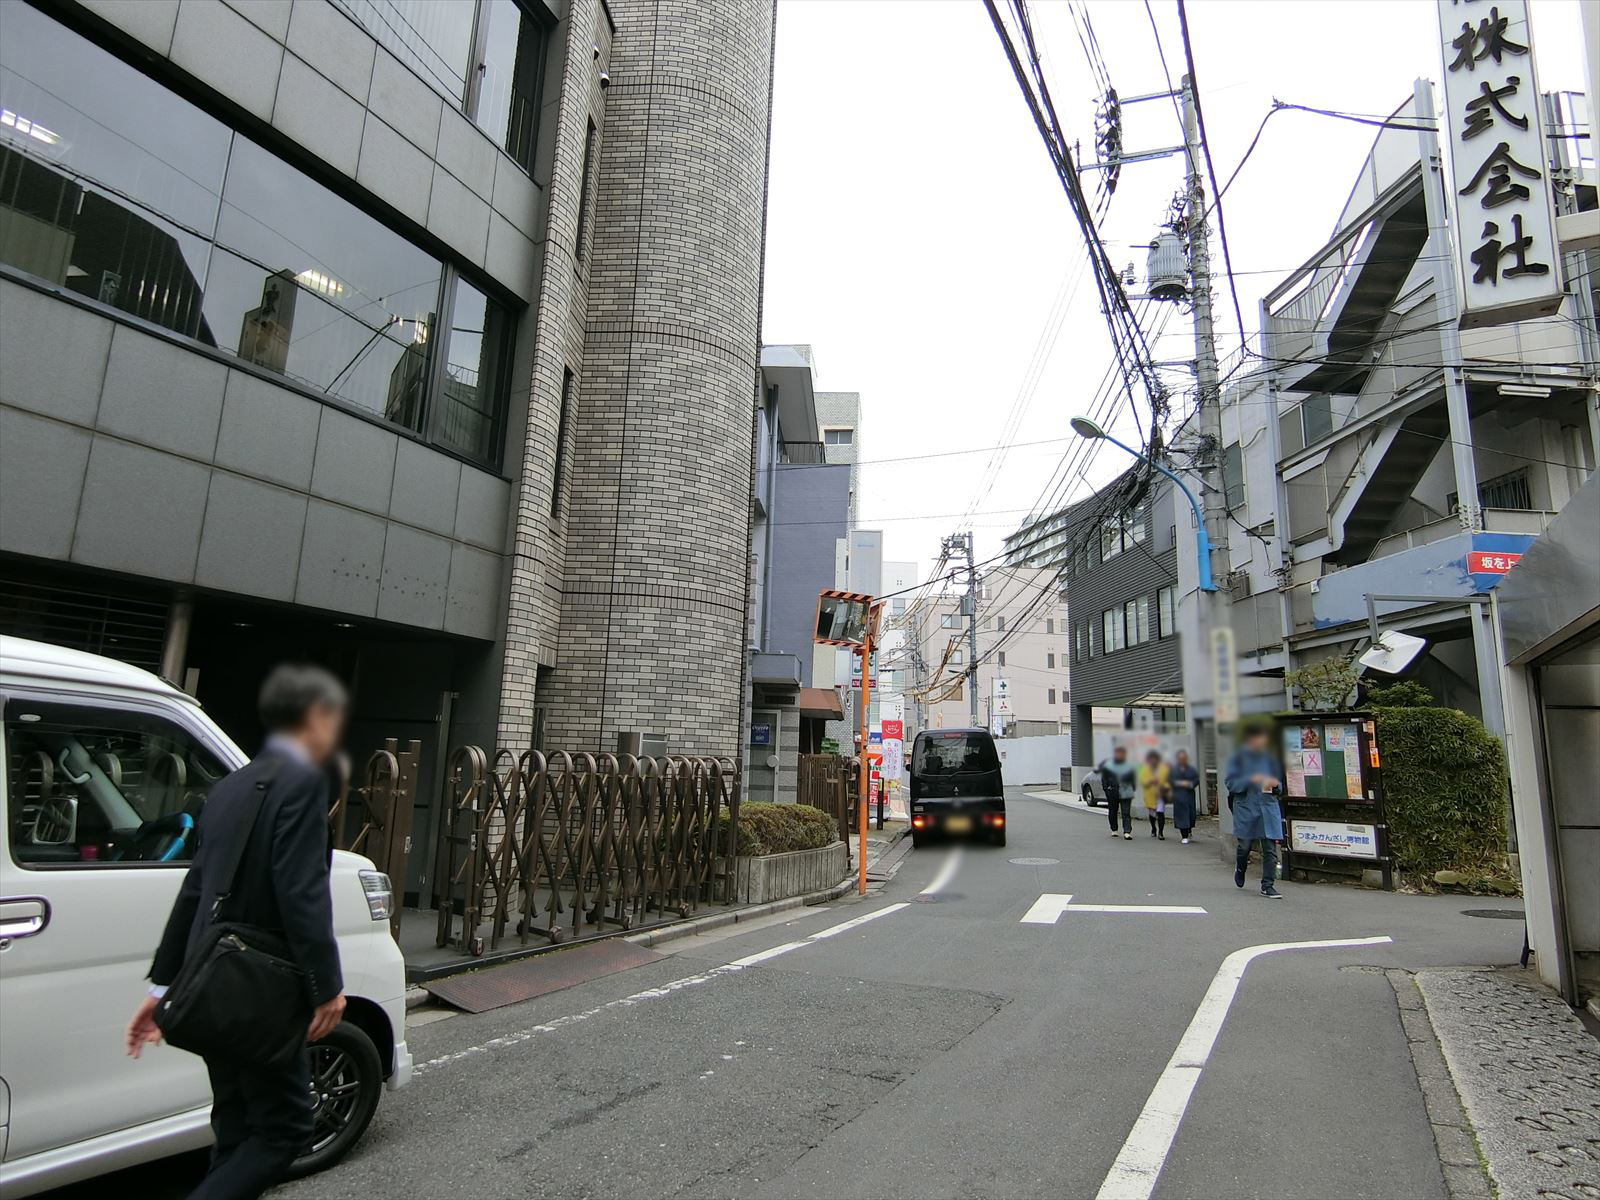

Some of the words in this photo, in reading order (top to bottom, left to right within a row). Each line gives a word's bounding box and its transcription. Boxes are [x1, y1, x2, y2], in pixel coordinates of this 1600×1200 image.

[1448, 0, 1549, 287] 株式会社
[1297, 832, 1370, 846] つまみかんざし博物館
